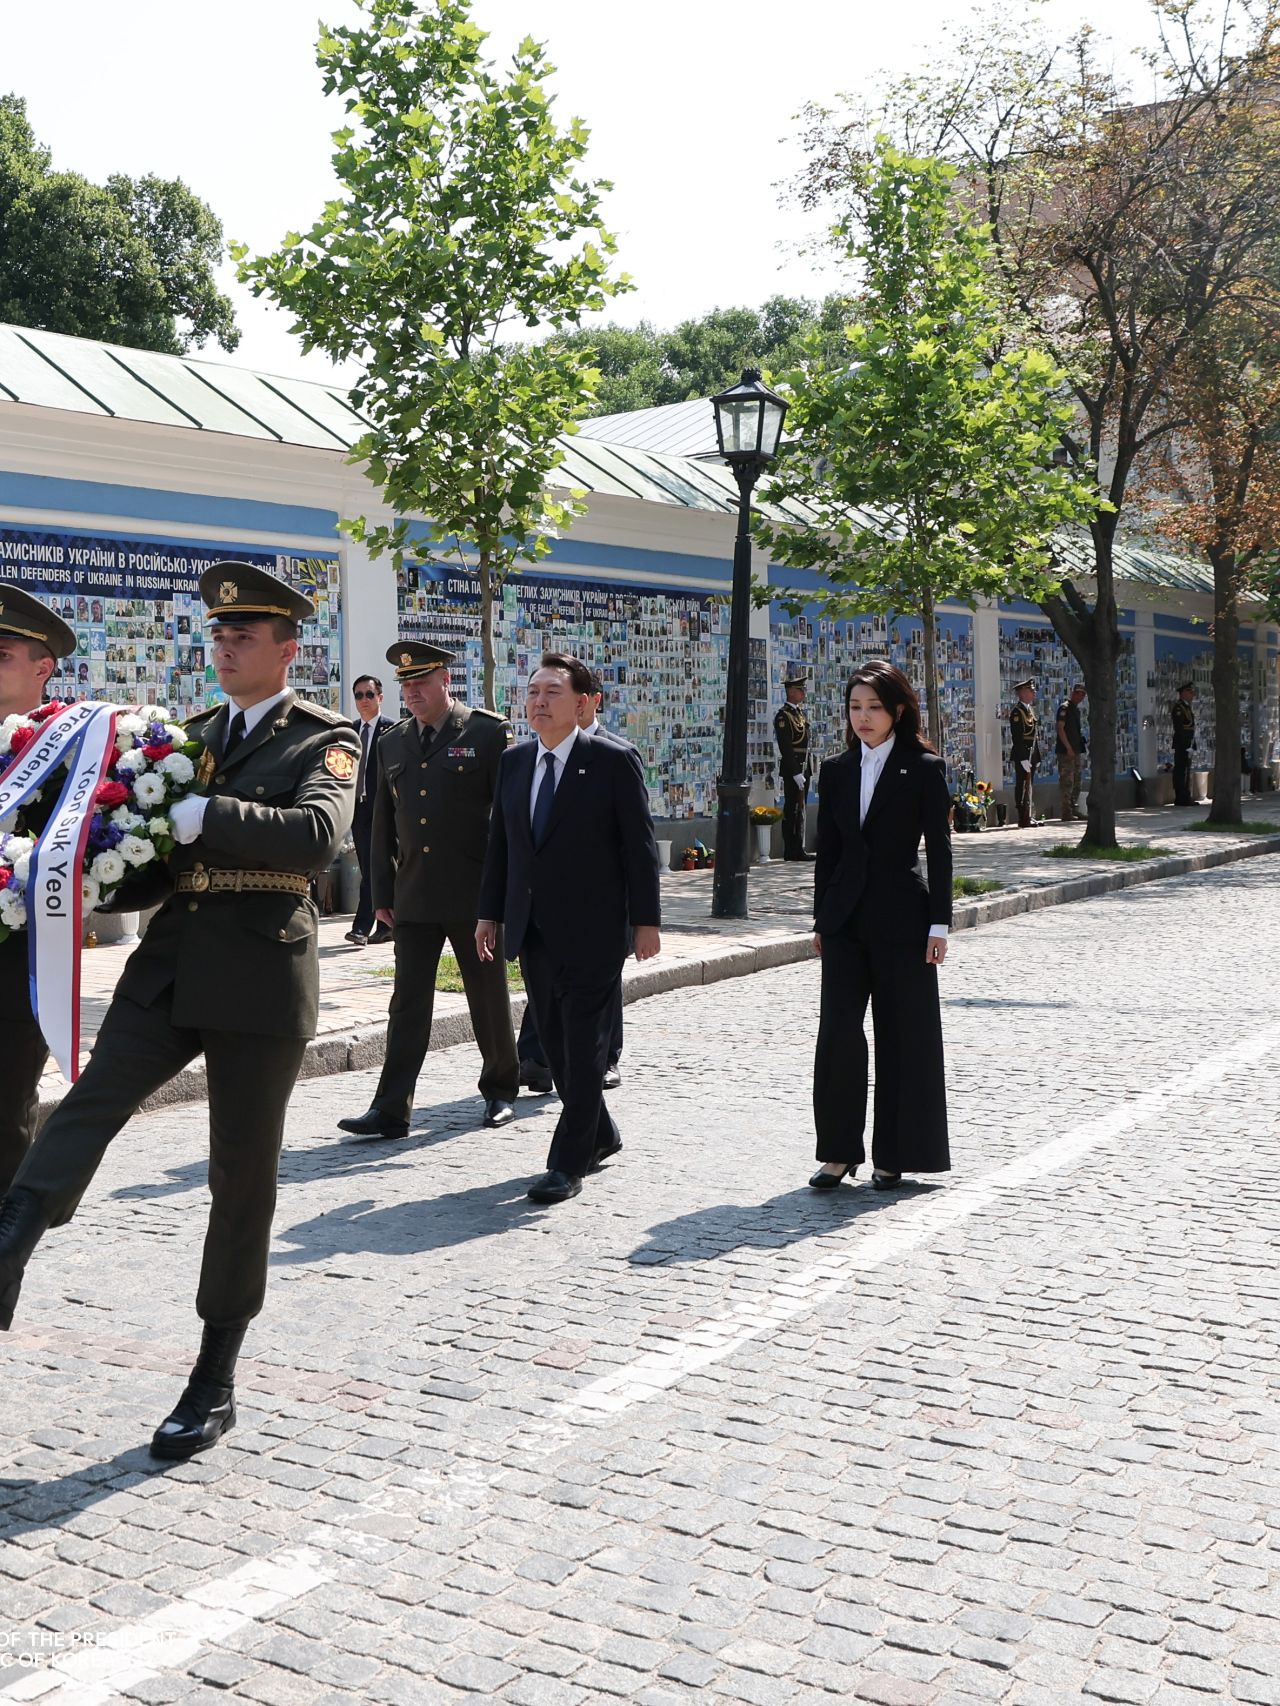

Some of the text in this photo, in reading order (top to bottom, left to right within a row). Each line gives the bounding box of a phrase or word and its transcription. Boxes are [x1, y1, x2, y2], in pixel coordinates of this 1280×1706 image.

[69, 547, 115, 566] УКРАЇНИ
[118, 551, 125, 569] В
[21, 566, 71, 583] DEFENDERS
[74, 571, 85, 584] OF
[87, 572, 123, 587] UKRAINE
[125, 575, 134, 587] IN
[448, 579, 470, 594] СТІНА
[538, 604, 552, 615] FALLE
[10, 706, 93, 789] President
[45, 762, 97, 918] Yoon Suk Yeol
